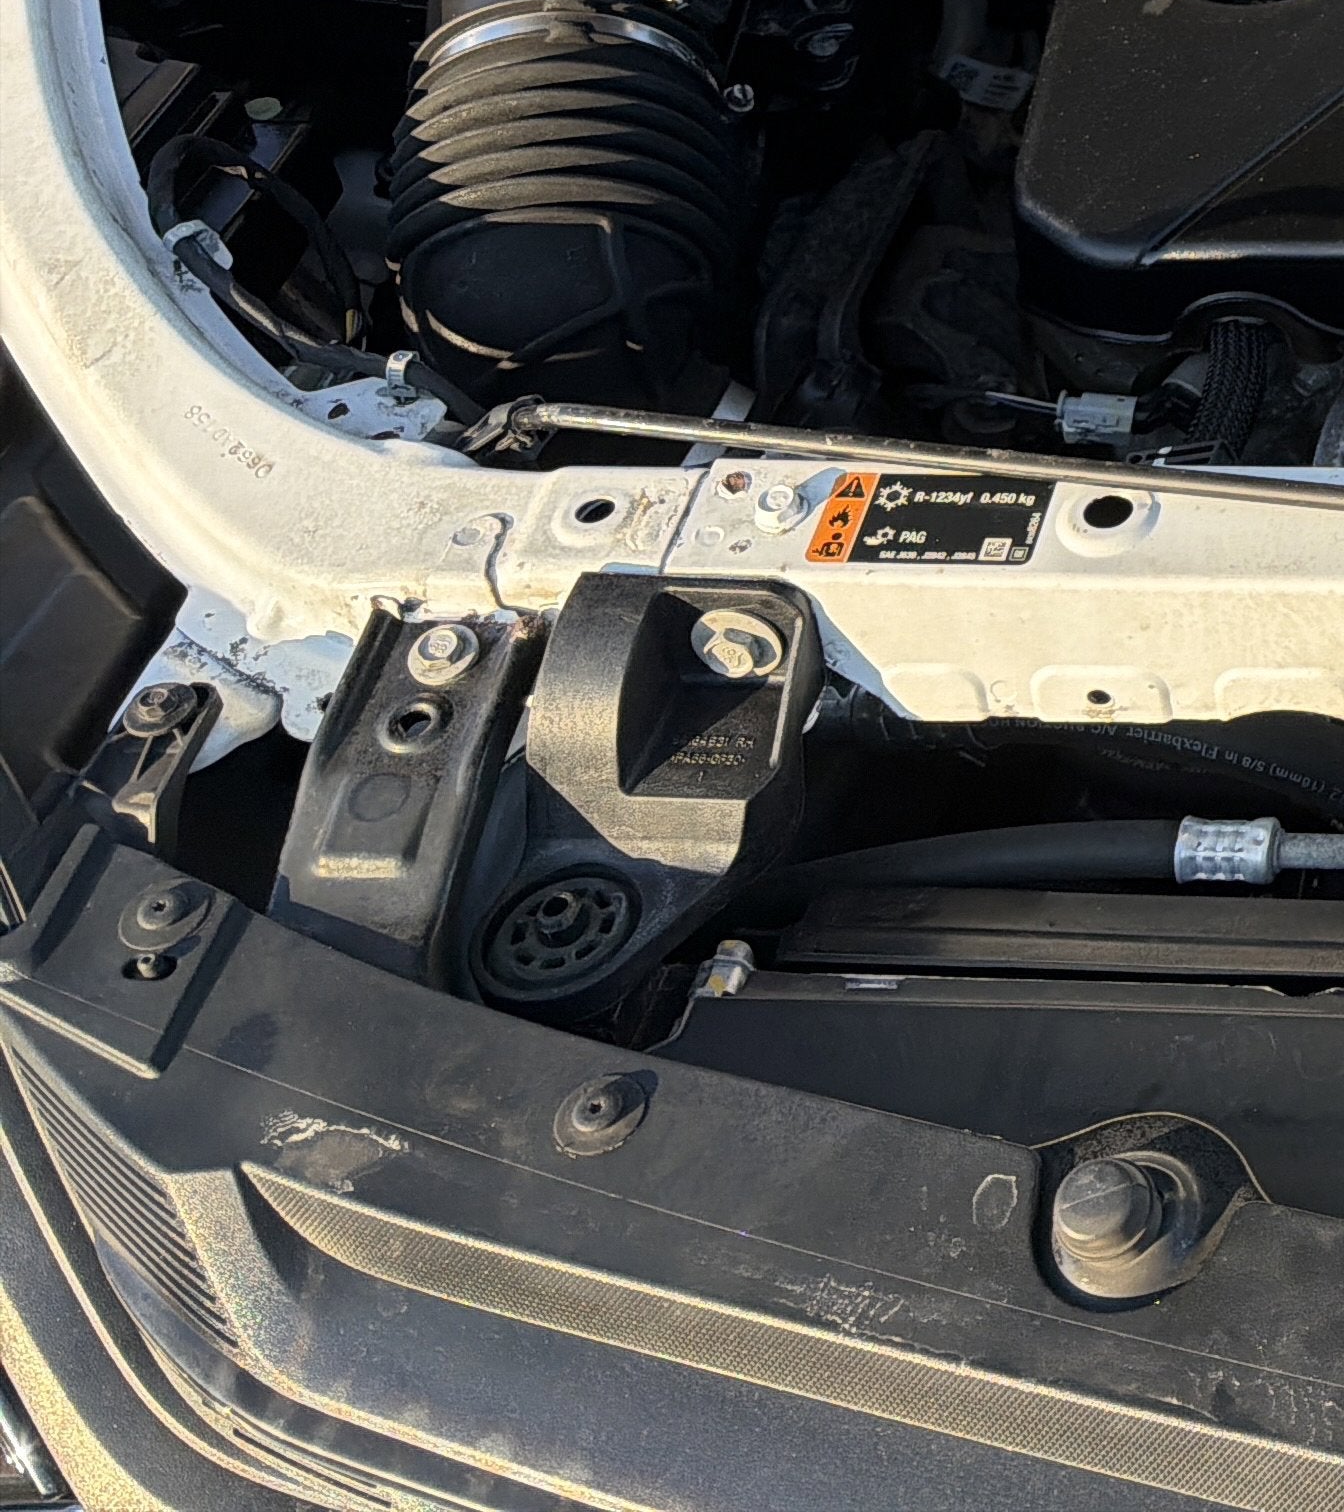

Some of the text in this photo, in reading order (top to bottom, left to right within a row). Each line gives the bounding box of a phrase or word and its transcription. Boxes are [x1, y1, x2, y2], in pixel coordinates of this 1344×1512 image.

[914, 491, 1036, 506] R-1234yf 0.450 kg
[899, 531, 927, 544] PAG
[1127, 727, 1219, 760] Flexbarrier
[1241, 755, 1266, 773] 5/8
